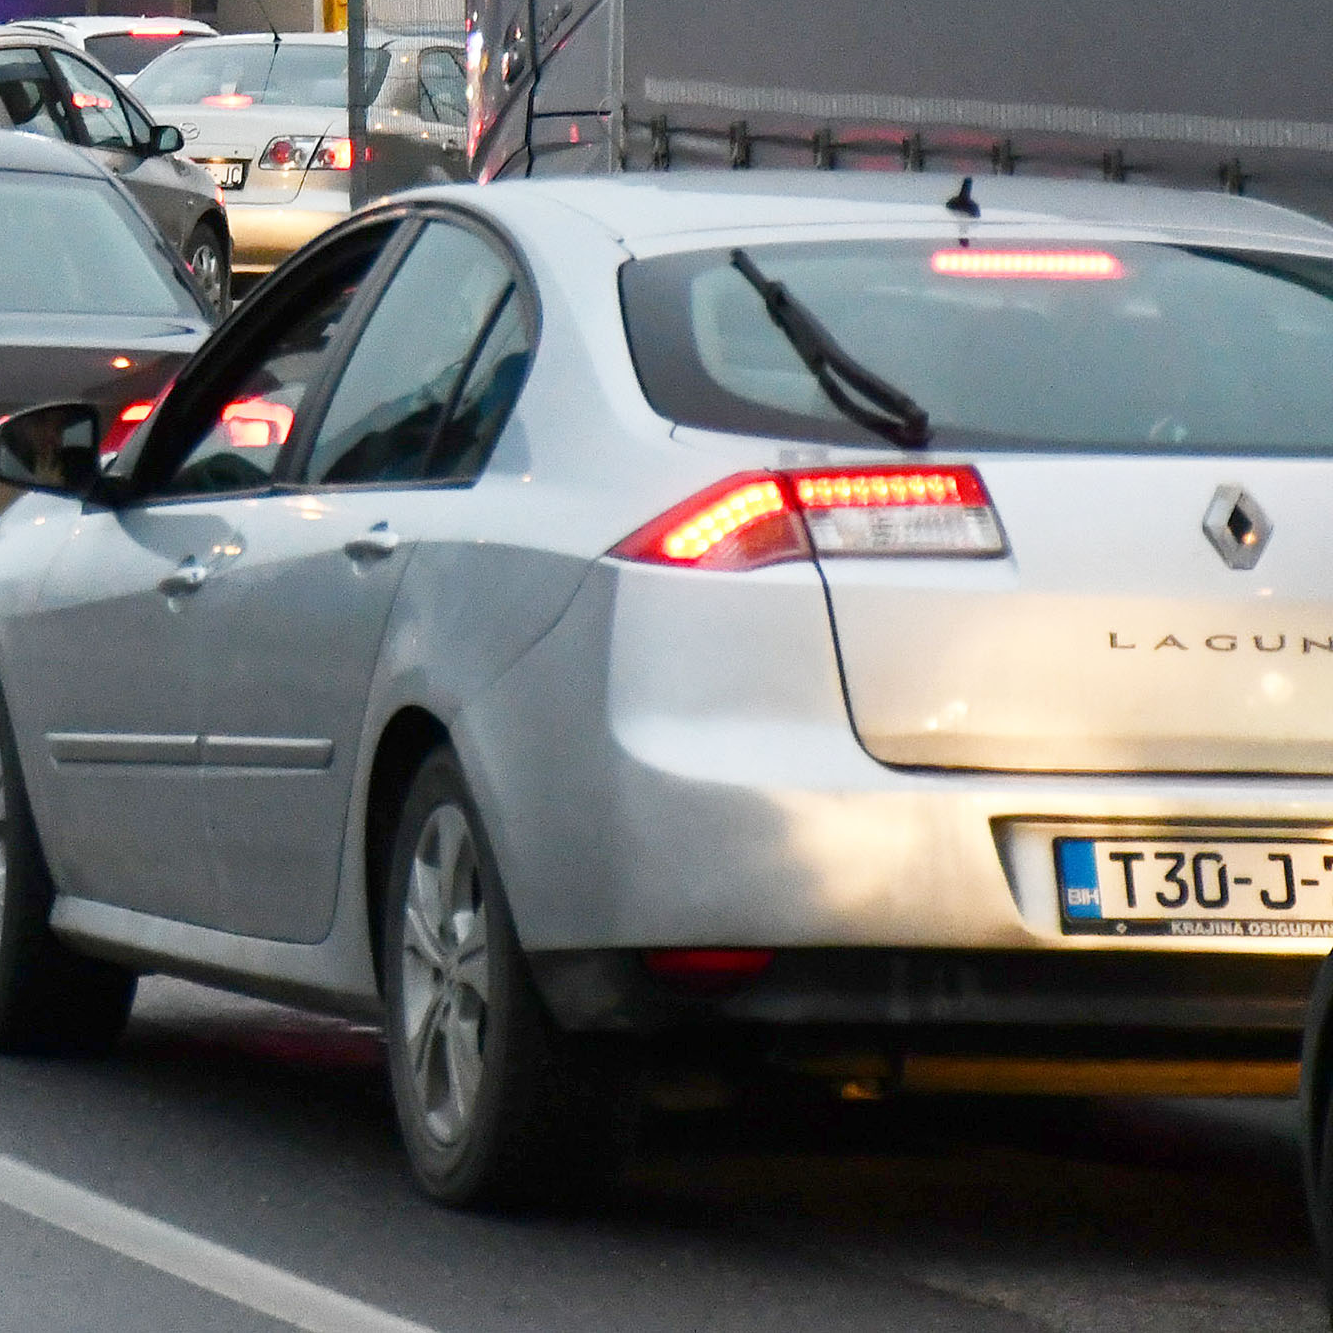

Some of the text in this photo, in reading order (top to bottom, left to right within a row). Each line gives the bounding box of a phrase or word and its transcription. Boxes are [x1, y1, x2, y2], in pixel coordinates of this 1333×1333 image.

[1109, 632, 1333, 654] LAGUN
[1067, 888, 1099, 906] BIH
[1171, 919, 1243, 936] KRAJINA
